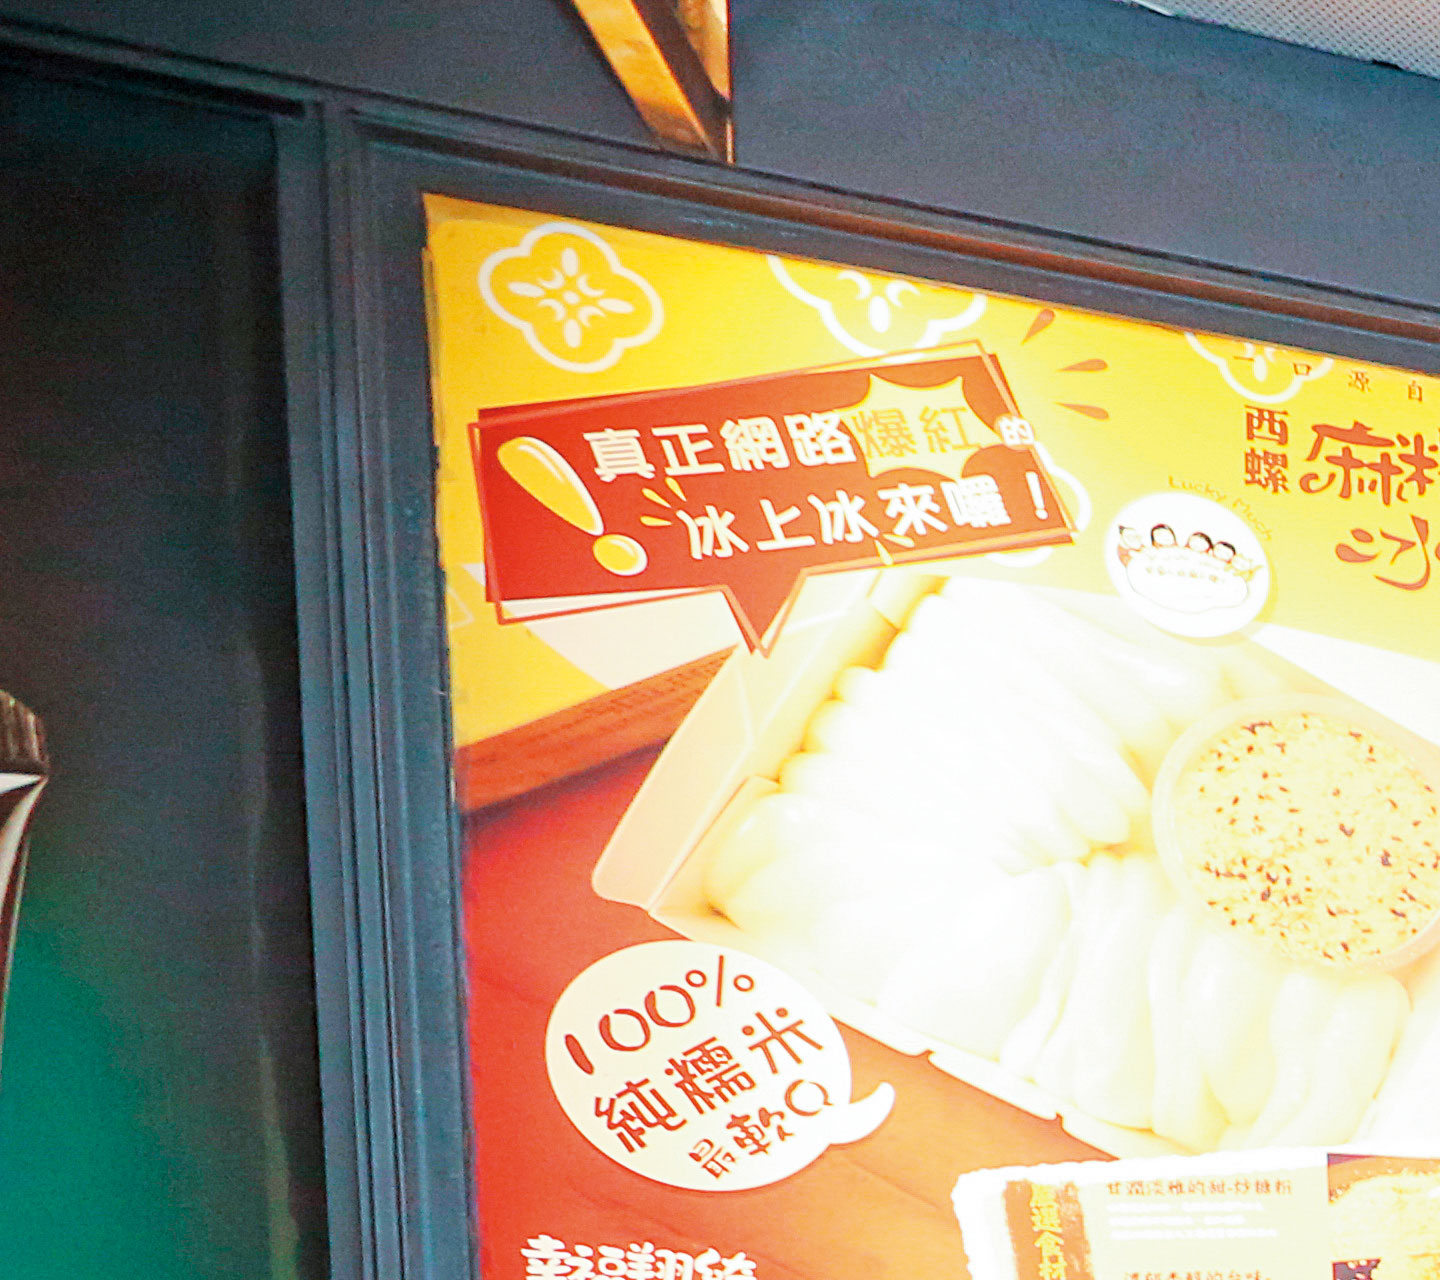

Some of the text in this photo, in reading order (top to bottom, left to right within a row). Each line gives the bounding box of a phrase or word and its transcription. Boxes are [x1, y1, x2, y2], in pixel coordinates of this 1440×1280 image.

[583, 405, 1034, 482] 真正網路爆紅的
[1244, 404, 1289, 495] 西螺
[564, 954, 755, 1076] 100%
[594, 1006, 823, 1154] 純糯米
[689, 1079, 836, 1179] 最軟Q
